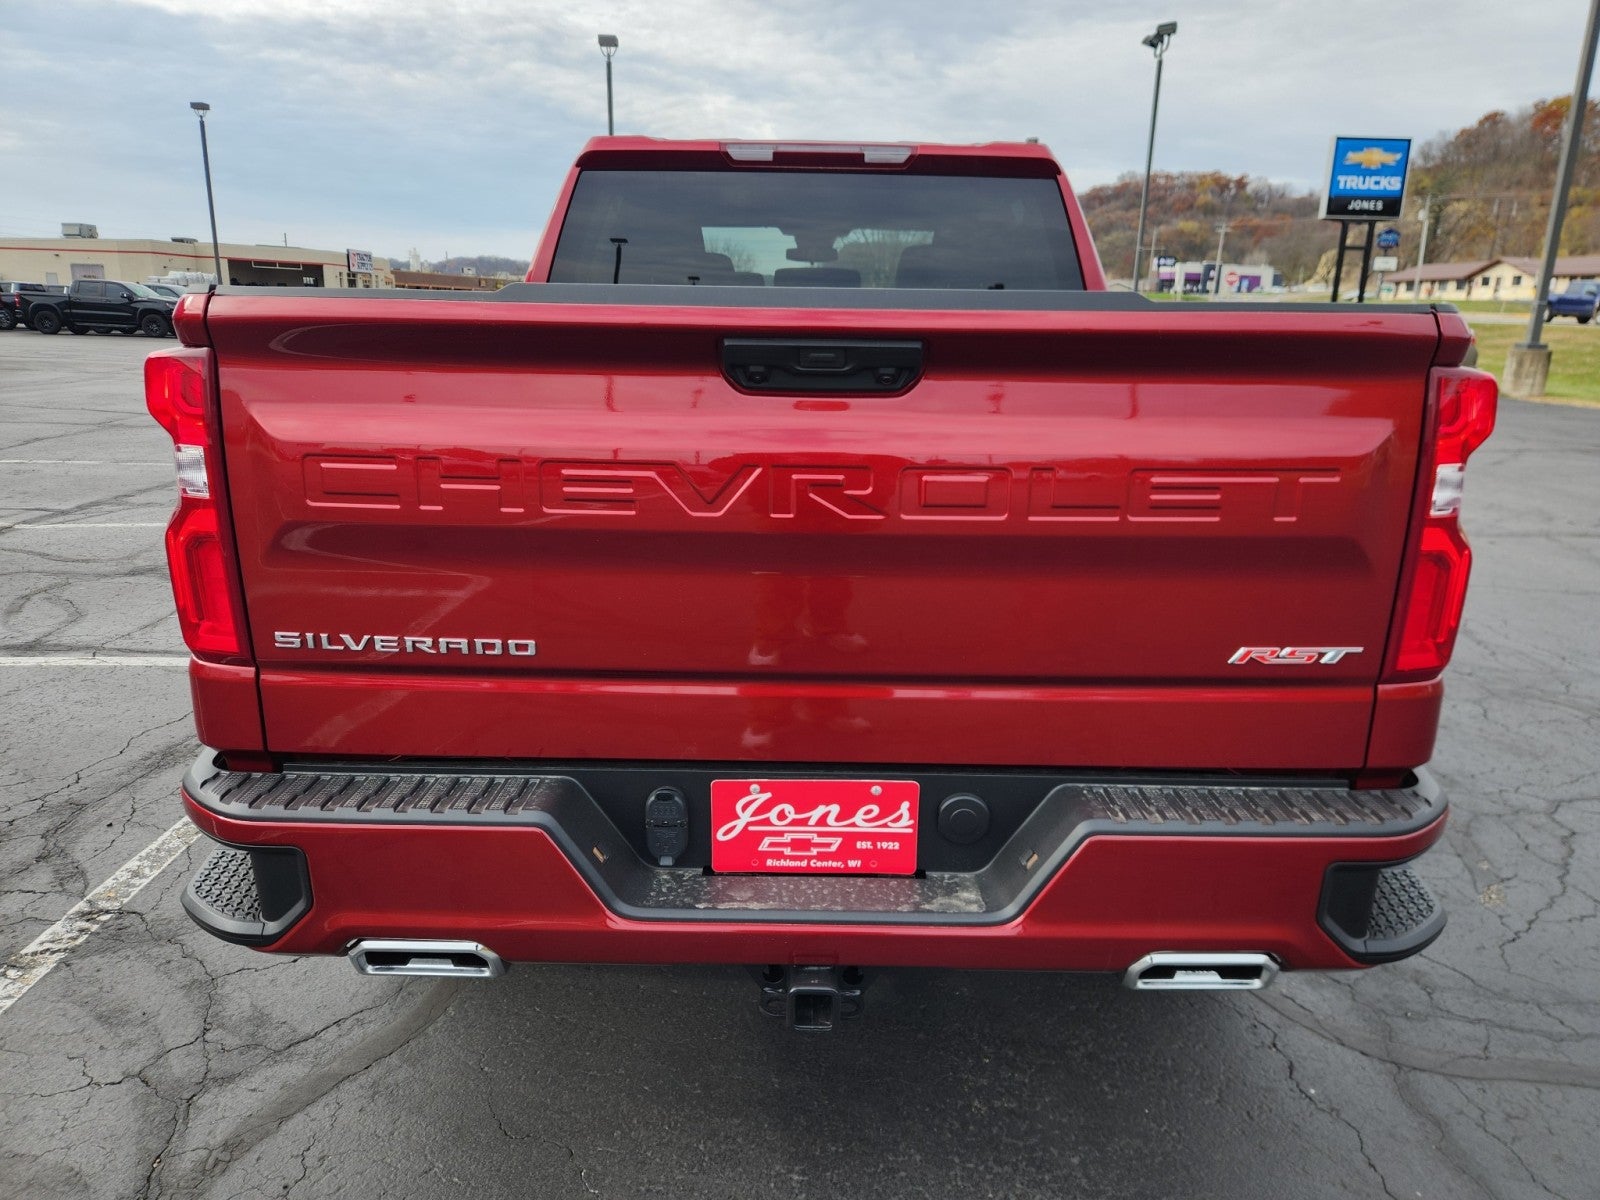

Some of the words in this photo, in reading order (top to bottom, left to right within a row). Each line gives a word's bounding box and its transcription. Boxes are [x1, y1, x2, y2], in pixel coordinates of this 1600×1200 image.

[1337, 175, 1402, 191] TRUCKS
[1347, 199, 1384, 211] JONES
[302, 454, 1342, 523] CHEVROLET
[274, 631, 536, 656] SILVERADO
[1227, 646, 1364, 664] RST
[716, 792, 915, 841] Jones
[856, 841, 874, 850] EST.
[876, 841, 900, 850] 1922
[766, 859, 808, 868] Richland
[809, 859, 845, 869] Center,
[847, 859, 862, 868] WI
